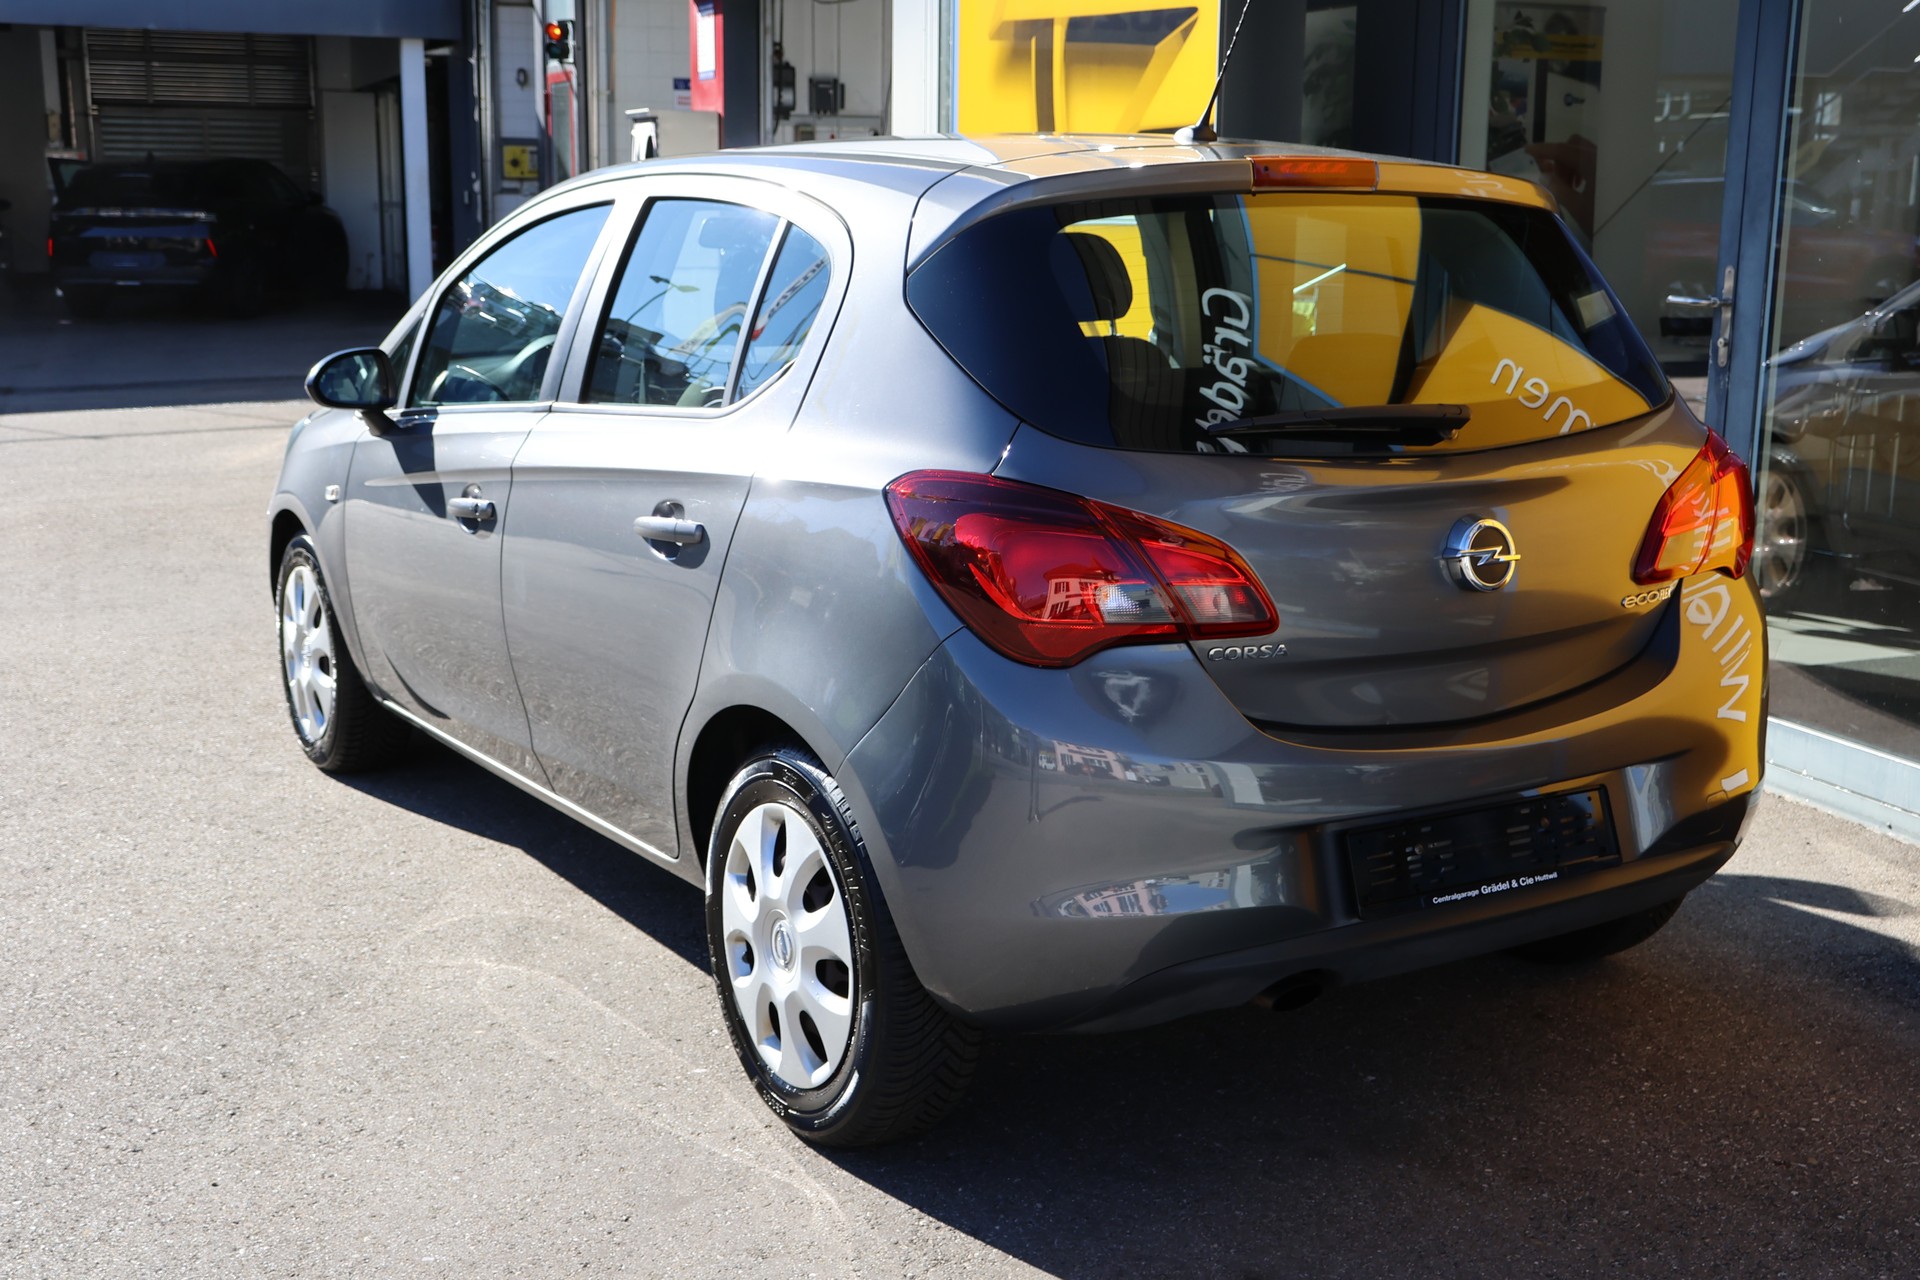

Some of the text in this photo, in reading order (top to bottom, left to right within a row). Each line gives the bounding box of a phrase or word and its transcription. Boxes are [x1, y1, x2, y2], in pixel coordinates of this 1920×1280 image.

[1208, 643, 1288, 661] CORSA
[1432, 871, 1558, 904] Centralgarage Grädel & Cie Huttwil
